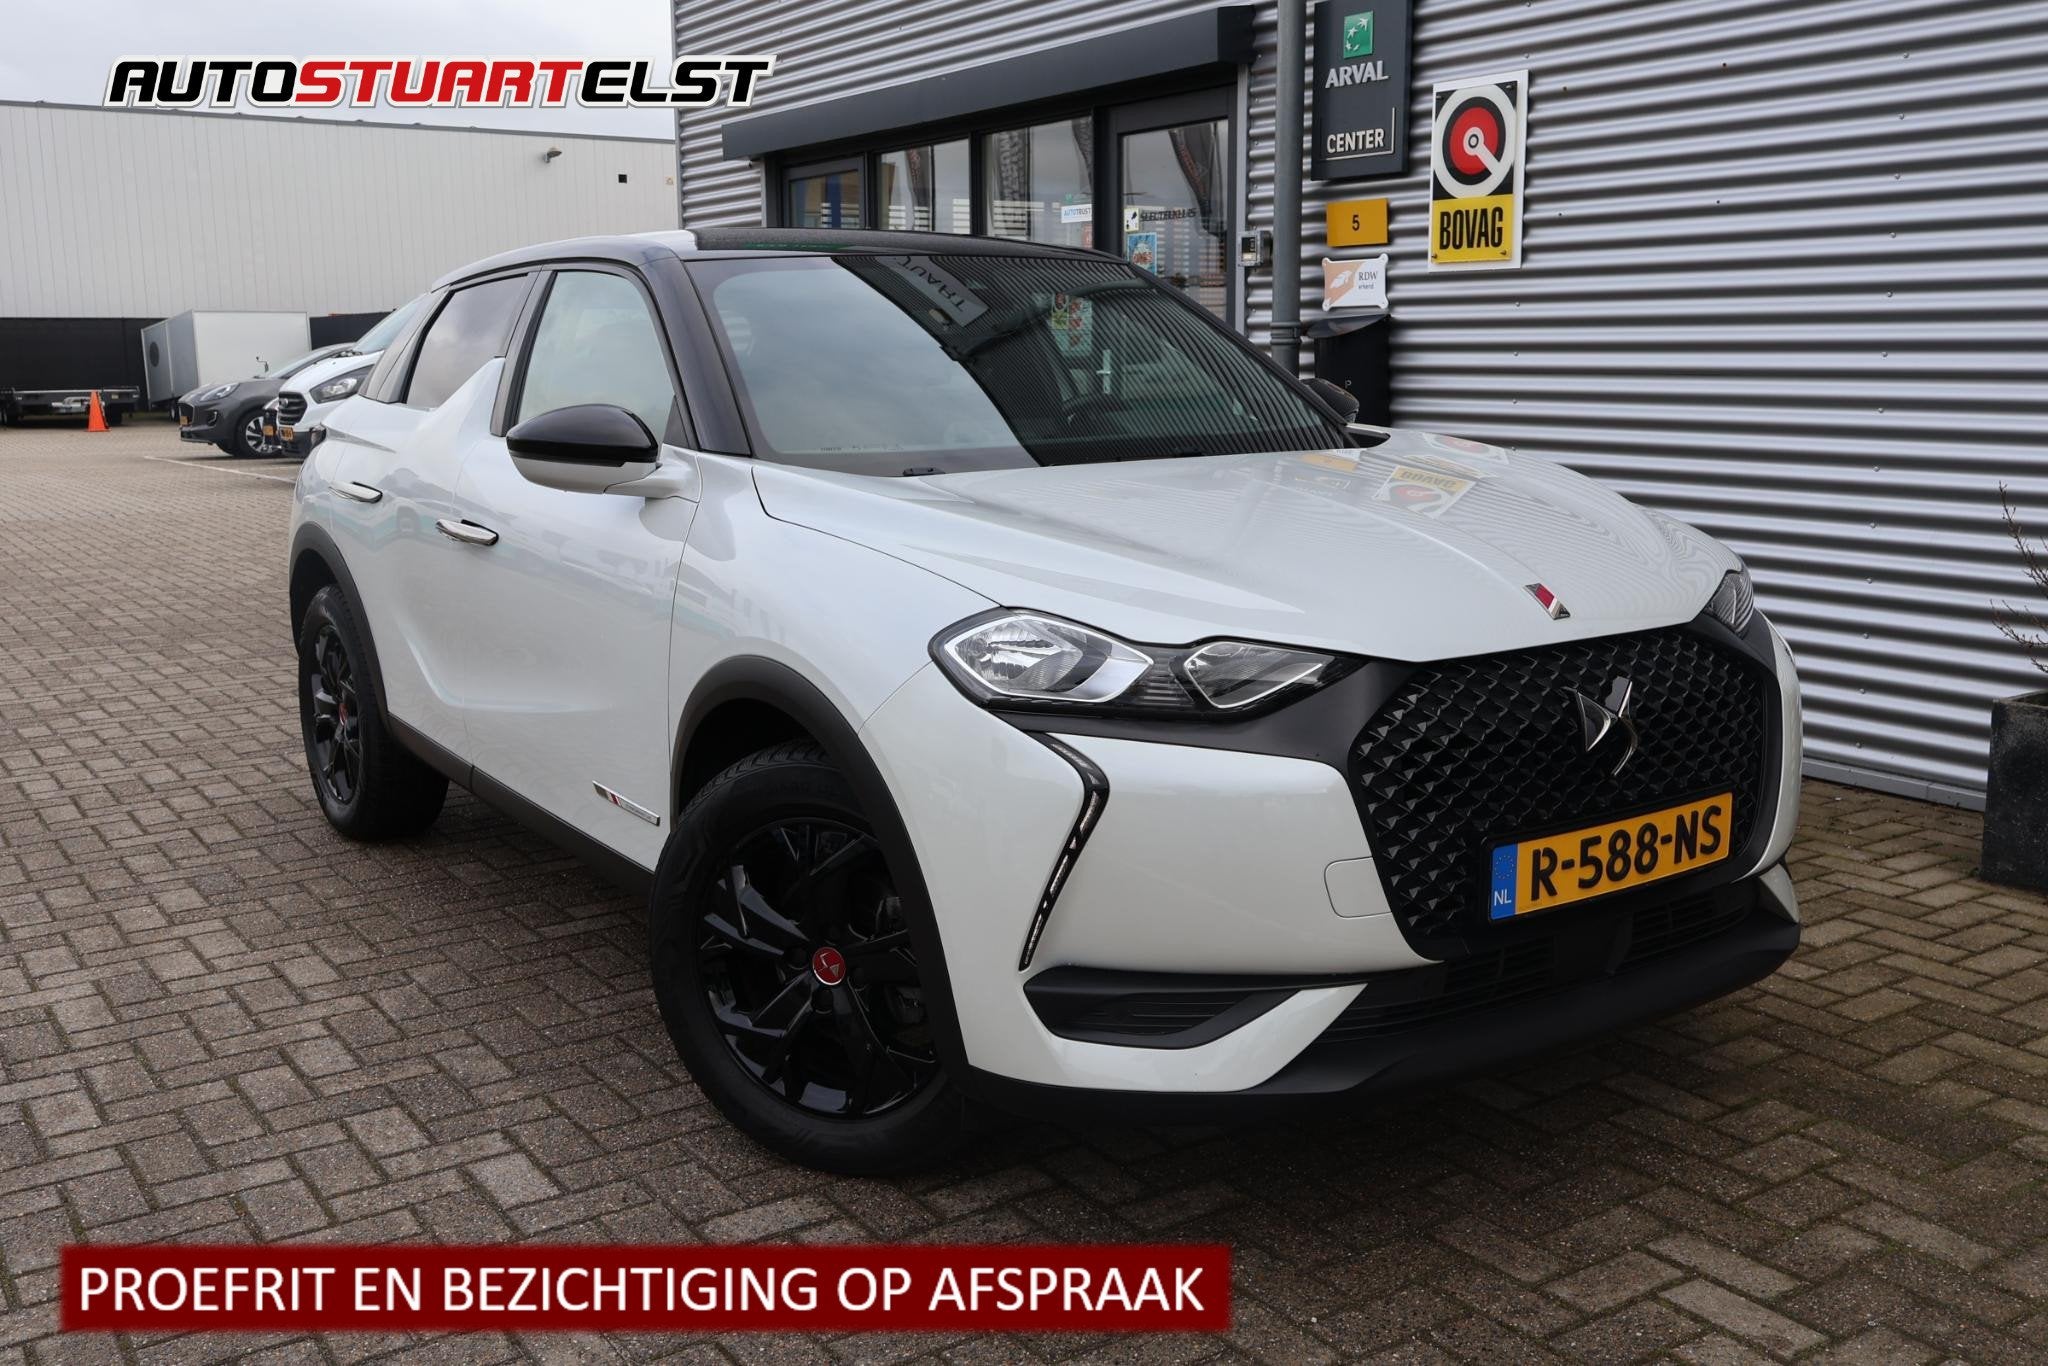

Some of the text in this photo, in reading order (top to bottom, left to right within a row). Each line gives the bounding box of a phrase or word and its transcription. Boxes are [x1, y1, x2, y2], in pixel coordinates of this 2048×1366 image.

[1325, 60, 1389, 89] ARVAL
[1326, 128, 1385, 154] CENTER
[1063, 207, 1091, 217] AUTOTRUST
[1351, 214, 1361, 231] 5
[1439, 206, 1504, 251] BOVAG
[1358, 270, 1378, 281] RDW
[1530, 804, 1722, 902] R-588-NS
[1493, 889, 1512, 906] NL
